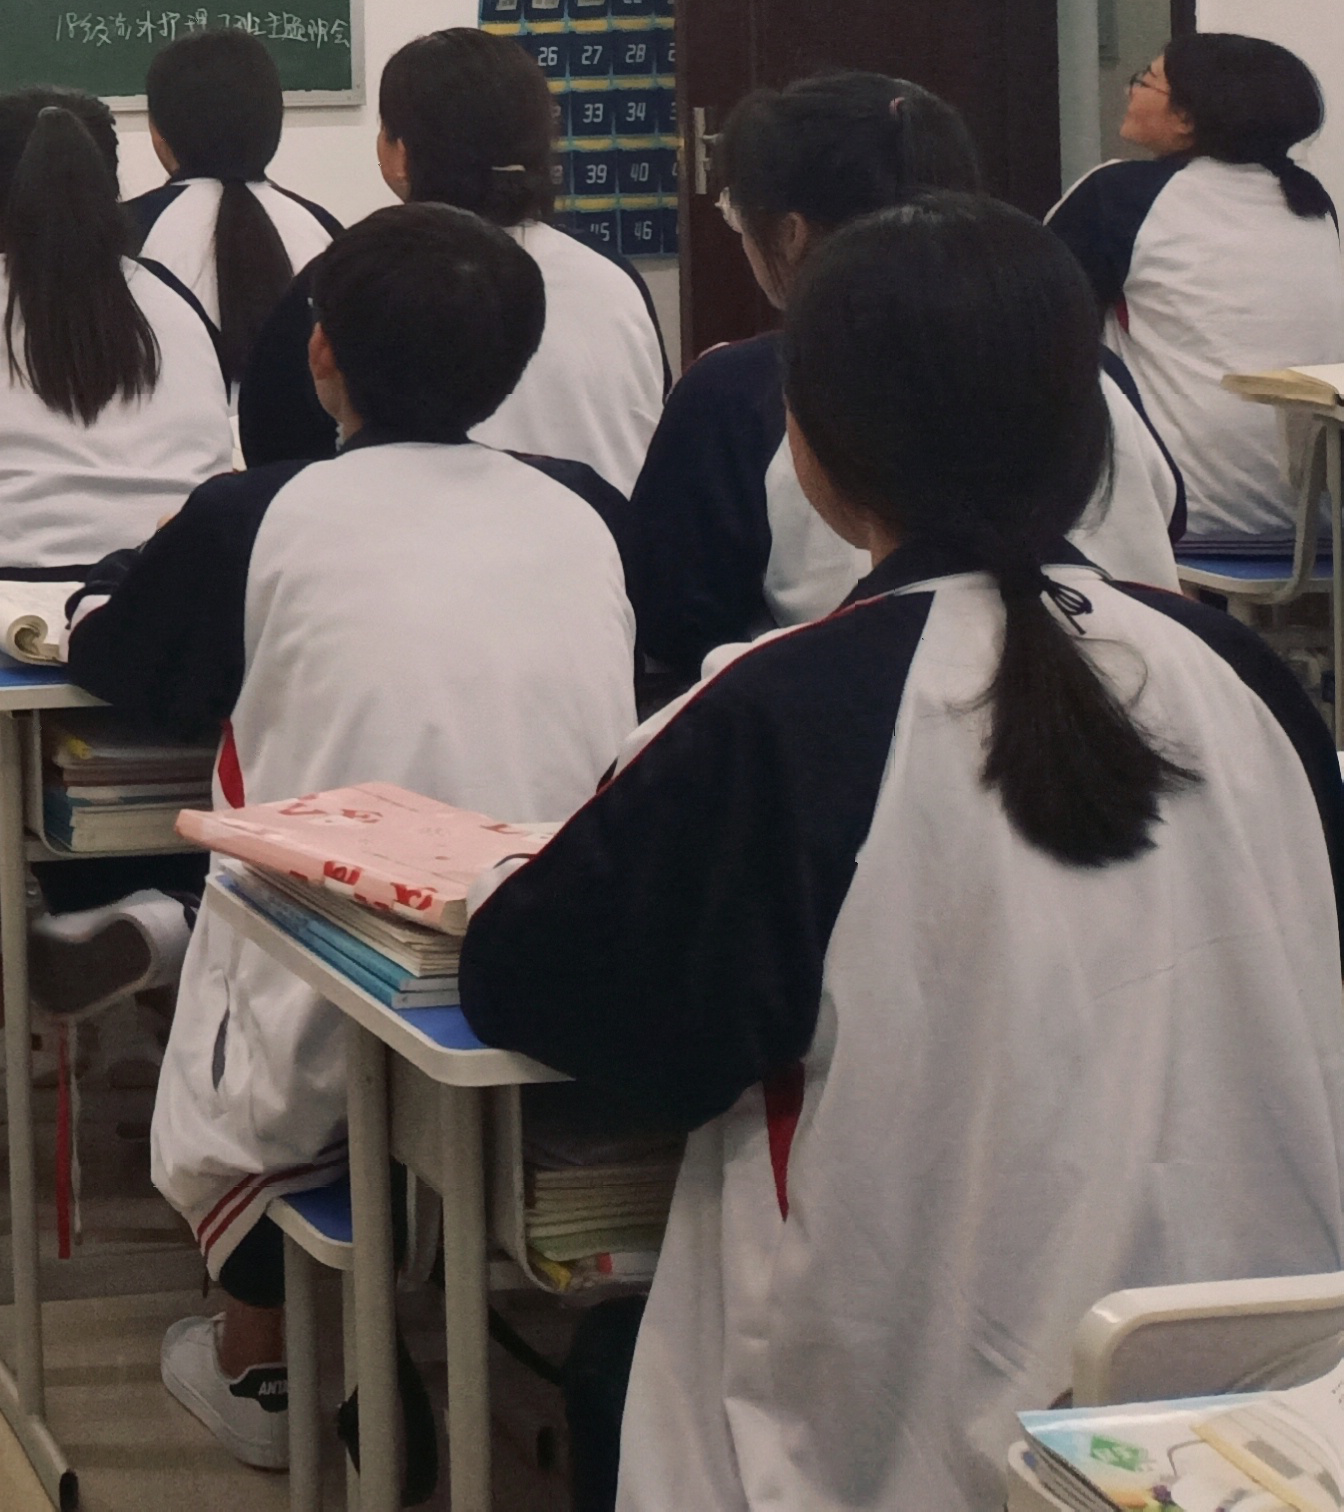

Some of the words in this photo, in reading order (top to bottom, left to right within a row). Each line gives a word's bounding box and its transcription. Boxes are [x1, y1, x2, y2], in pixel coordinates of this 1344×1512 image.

[537, 46, 558, 67] 26
[581, 45, 602, 65] 27
[625, 43, 646, 64] 28
[582, 102, 603, 123] 33
[625, 101, 646, 122] 34
[585, 164, 607, 184] 39
[630, 162, 649, 182] 40
[634, 220, 653, 240] 46
